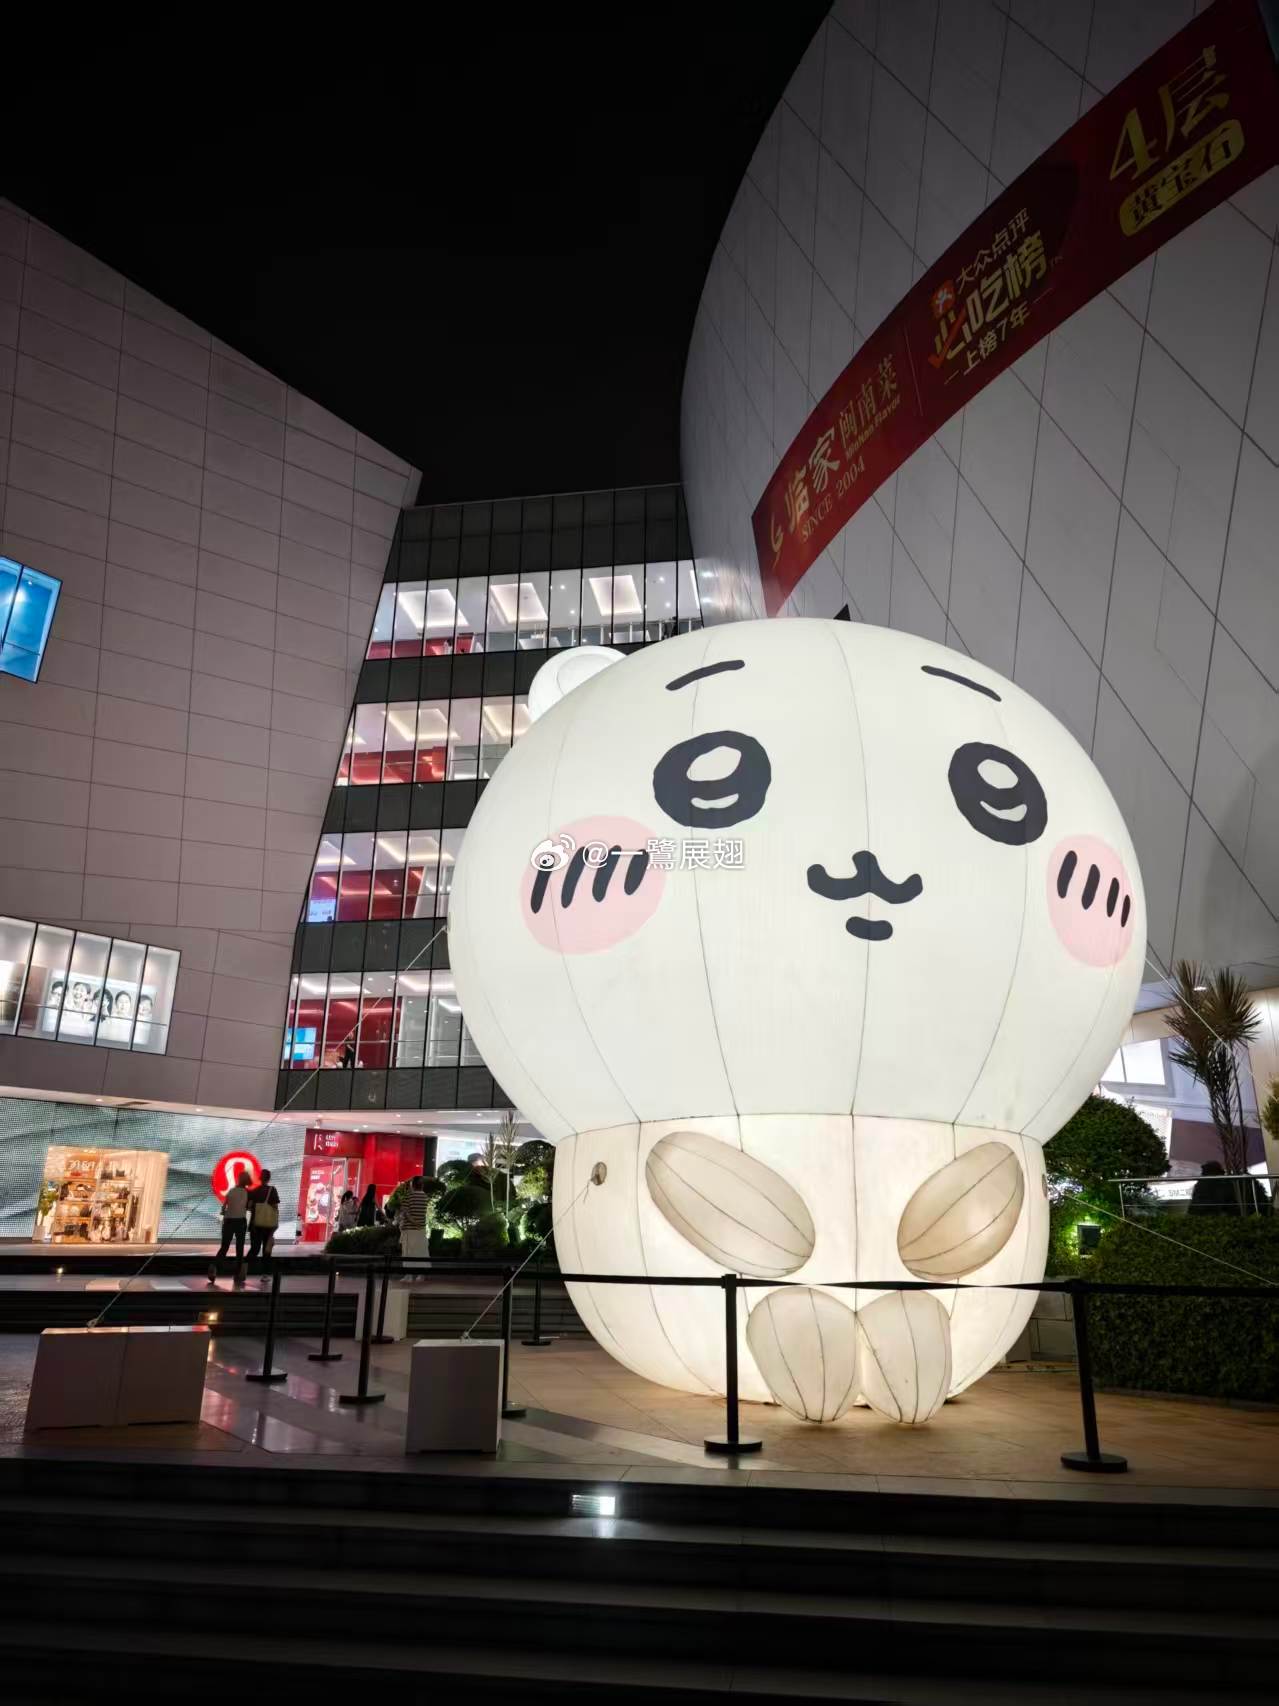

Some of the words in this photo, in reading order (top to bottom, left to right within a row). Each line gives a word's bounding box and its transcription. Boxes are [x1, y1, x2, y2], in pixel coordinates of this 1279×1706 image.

[1110, 45, 1231, 181] 4层
[956, 208, 1029, 295] 大众点评
[929, 230, 1047, 367] 必吃榜
[964, 300, 1031, 375] 上榜7年
[840, 354, 896, 450] 闽南菜
[801, 493, 833, 543] SINCE
[836, 456, 865, 498] 2004
